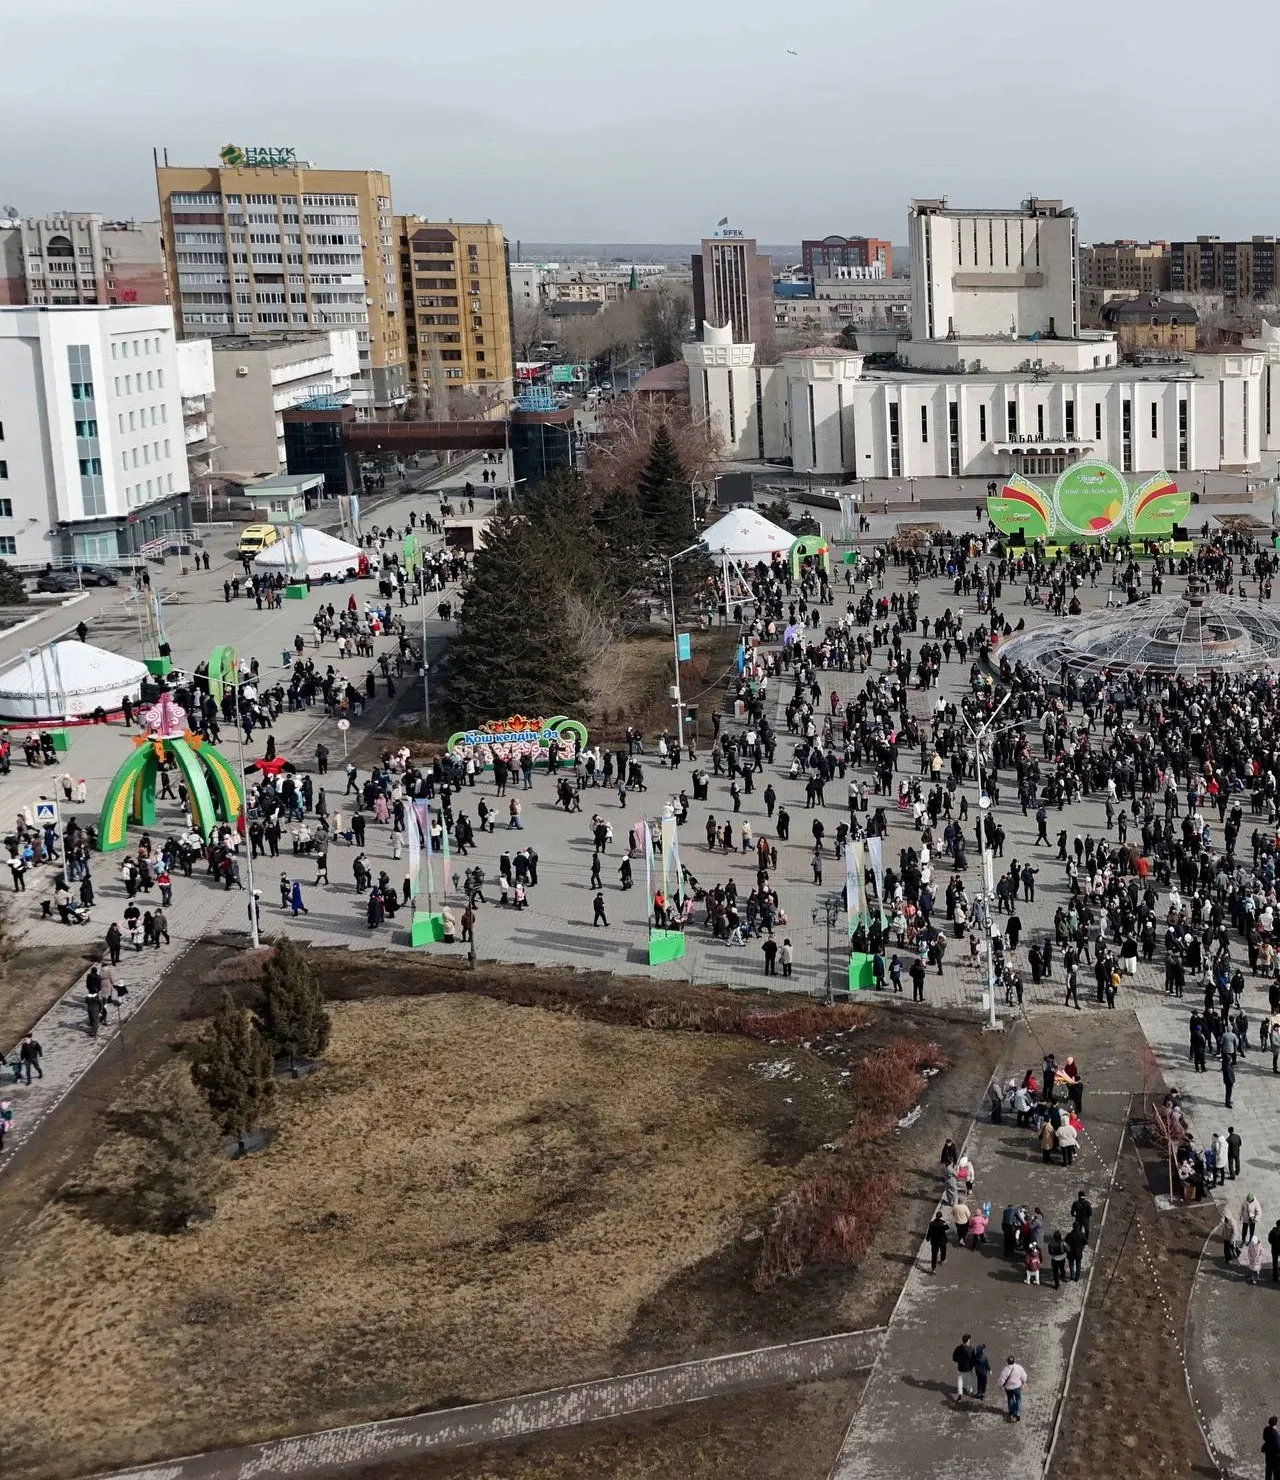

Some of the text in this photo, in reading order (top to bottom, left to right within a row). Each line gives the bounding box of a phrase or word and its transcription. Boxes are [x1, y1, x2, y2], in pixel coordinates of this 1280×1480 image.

[245, 147, 295, 156] HALYK
[246, 156, 292, 166] BANK
[464, 732, 493, 745] Қош
[543, 728, 559, 740] Әз
